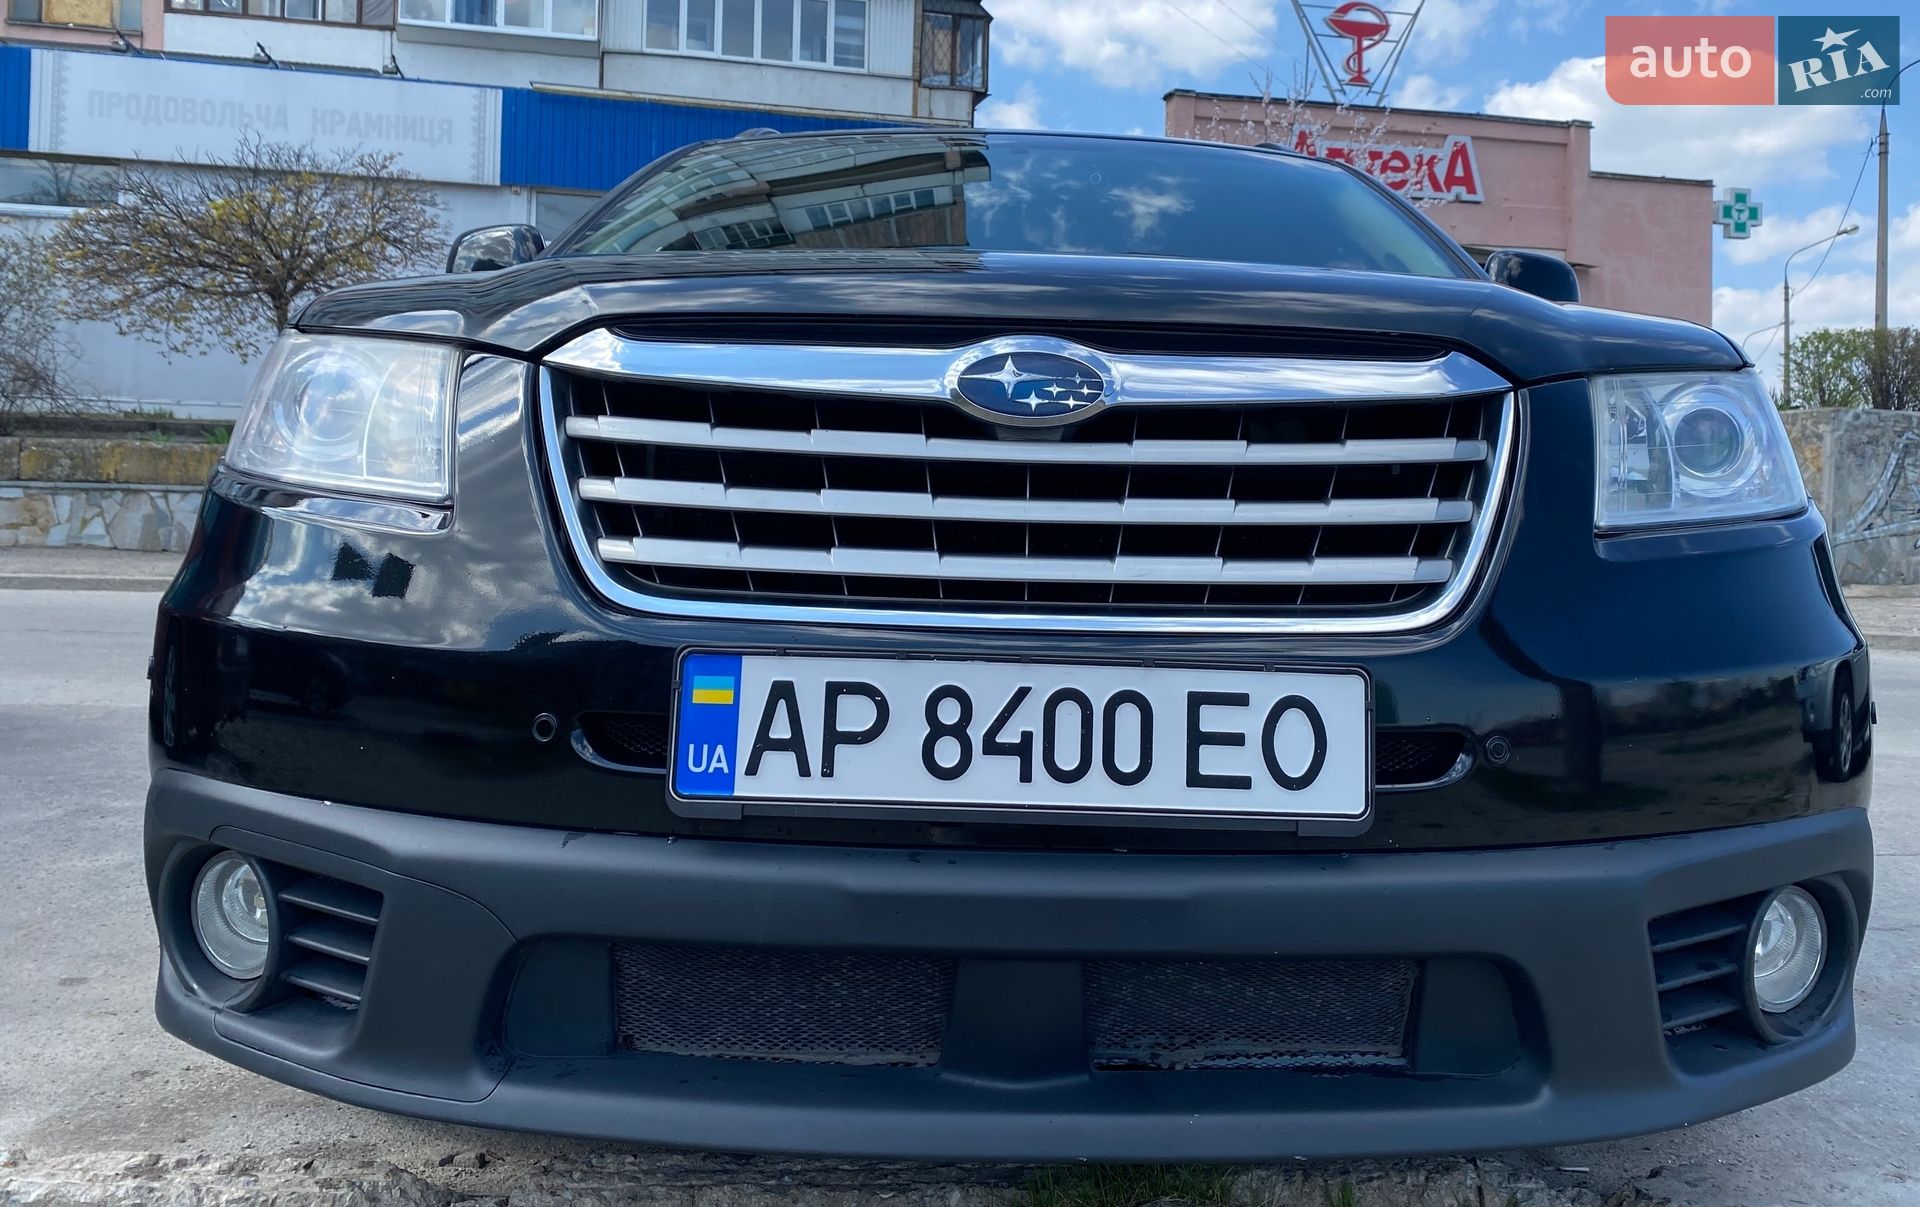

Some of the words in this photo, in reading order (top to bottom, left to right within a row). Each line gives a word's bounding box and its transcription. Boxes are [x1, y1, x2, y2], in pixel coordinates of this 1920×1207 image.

[87, 89, 289, 132] ПРОДОВОЛЬЧА
[311, 108, 454, 148] КРАМНИЦЯ
[687, 742, 730, 775] UA
[743, 679, 890, 779] AP
[920, 683, 1155, 787] 8400
[1186, 689, 1329, 792] EO
